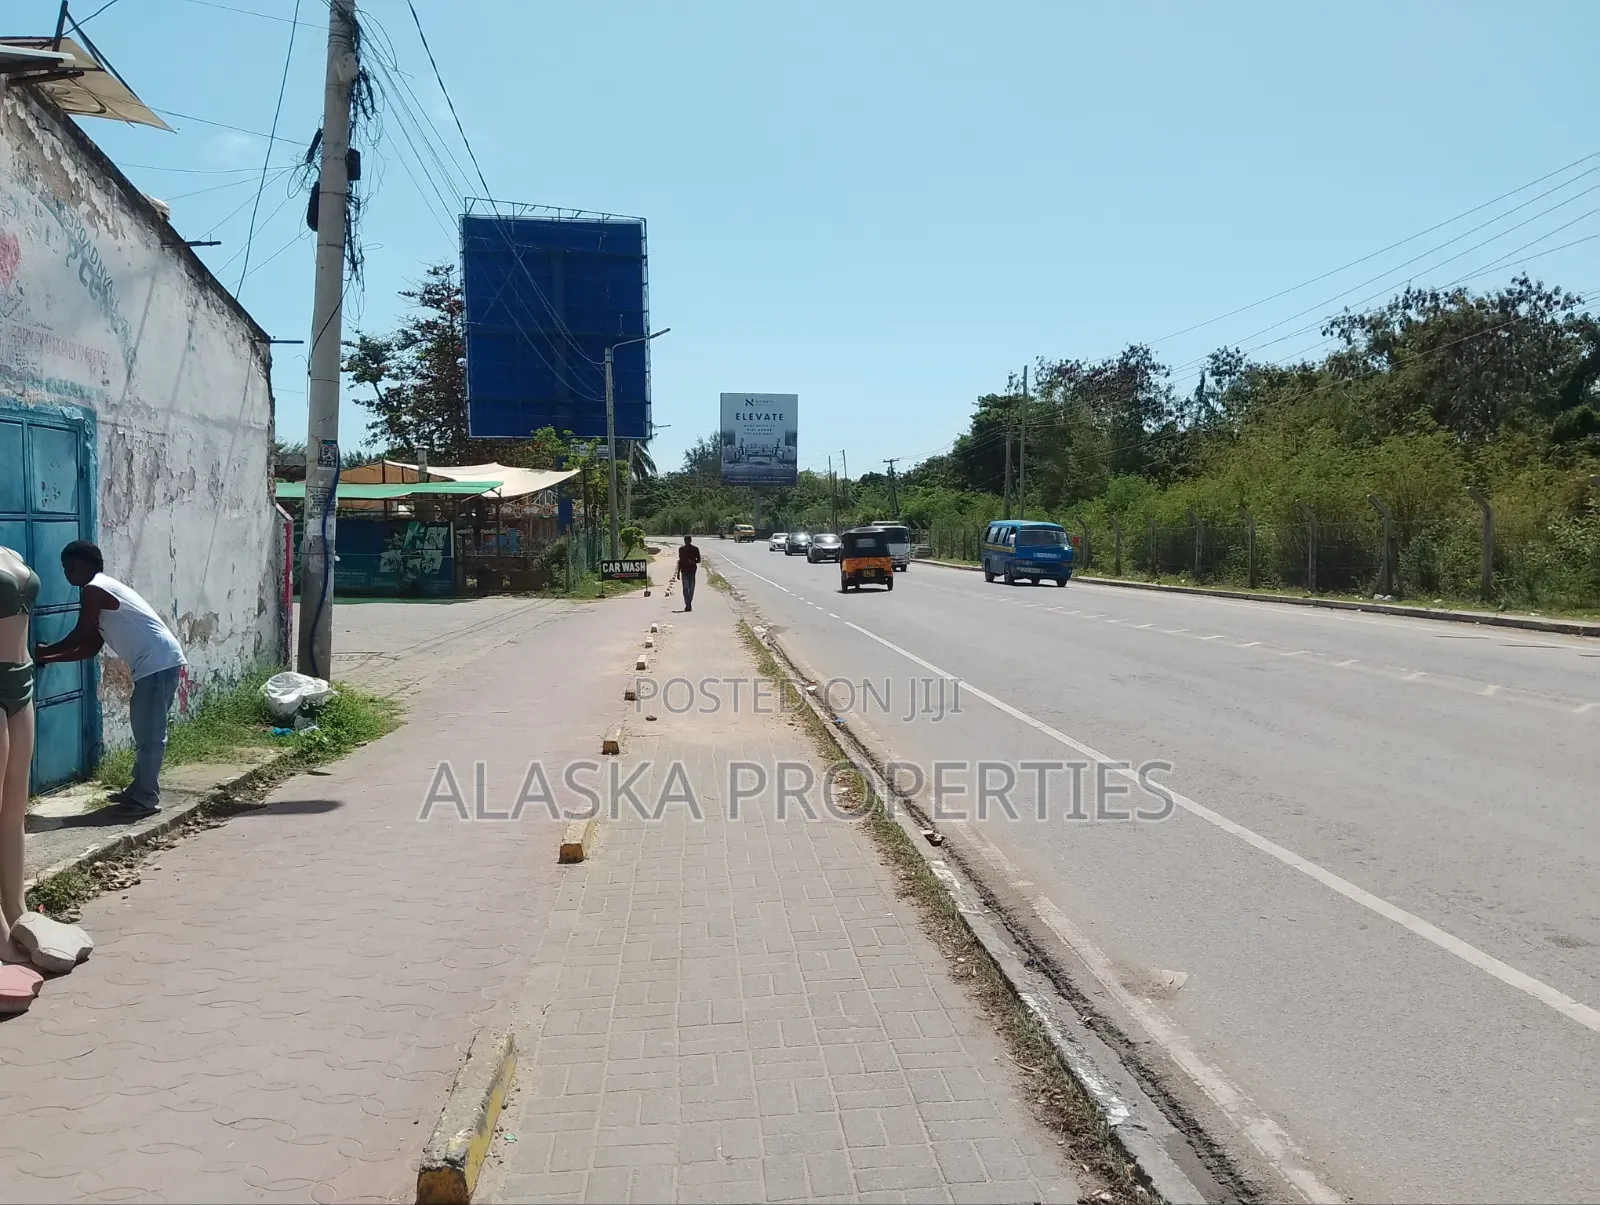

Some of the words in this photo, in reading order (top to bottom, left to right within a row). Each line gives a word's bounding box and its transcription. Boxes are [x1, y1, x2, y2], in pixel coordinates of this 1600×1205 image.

[735, 412, 784, 421] ELEVATE
[602, 562, 621, 573] CAR
[621, 561, 645, 573] WASH
